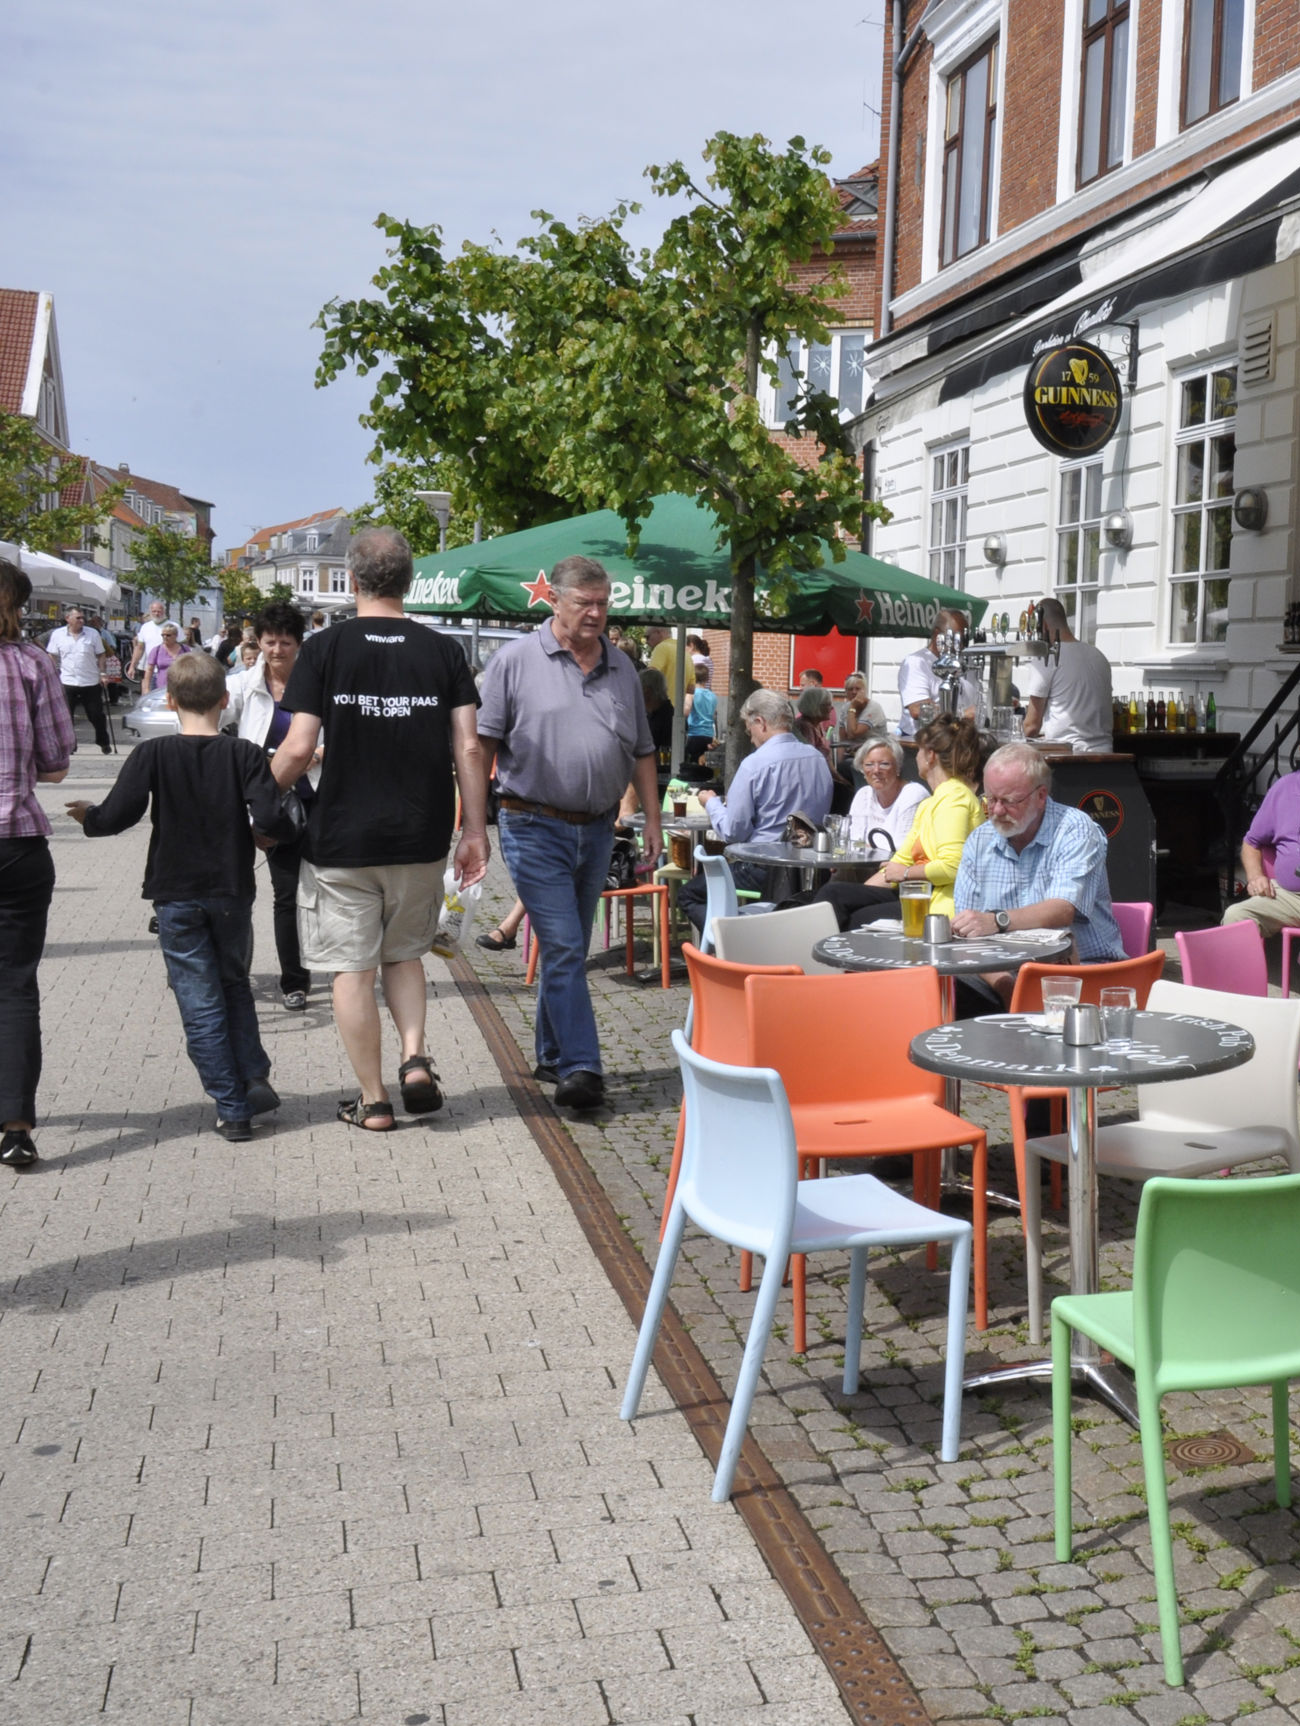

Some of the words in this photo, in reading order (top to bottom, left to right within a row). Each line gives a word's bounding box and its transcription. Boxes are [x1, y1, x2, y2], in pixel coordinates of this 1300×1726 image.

[1061, 371, 1071, 382] 17
[1088, 372, 1100, 384] 59
[1034, 386, 1118, 408] GUINNESS
[403, 570, 463, 604] ineken
[365, 634, 405, 643] vmware
[333, 694, 356, 705] YOU
[358, 695, 379, 706] BET
[381, 696, 409, 707] YOUR
[411, 696, 438, 706] PAAS
[361, 705, 381, 716] IT'S
[382, 706, 411, 717] OPEN
[826, 948, 951, 966] Denmark
[1161, 1014, 1232, 1030] Irish
[1217, 1030, 1251, 1047] Pub
[925, 1042, 1083, 1074] Denmark
